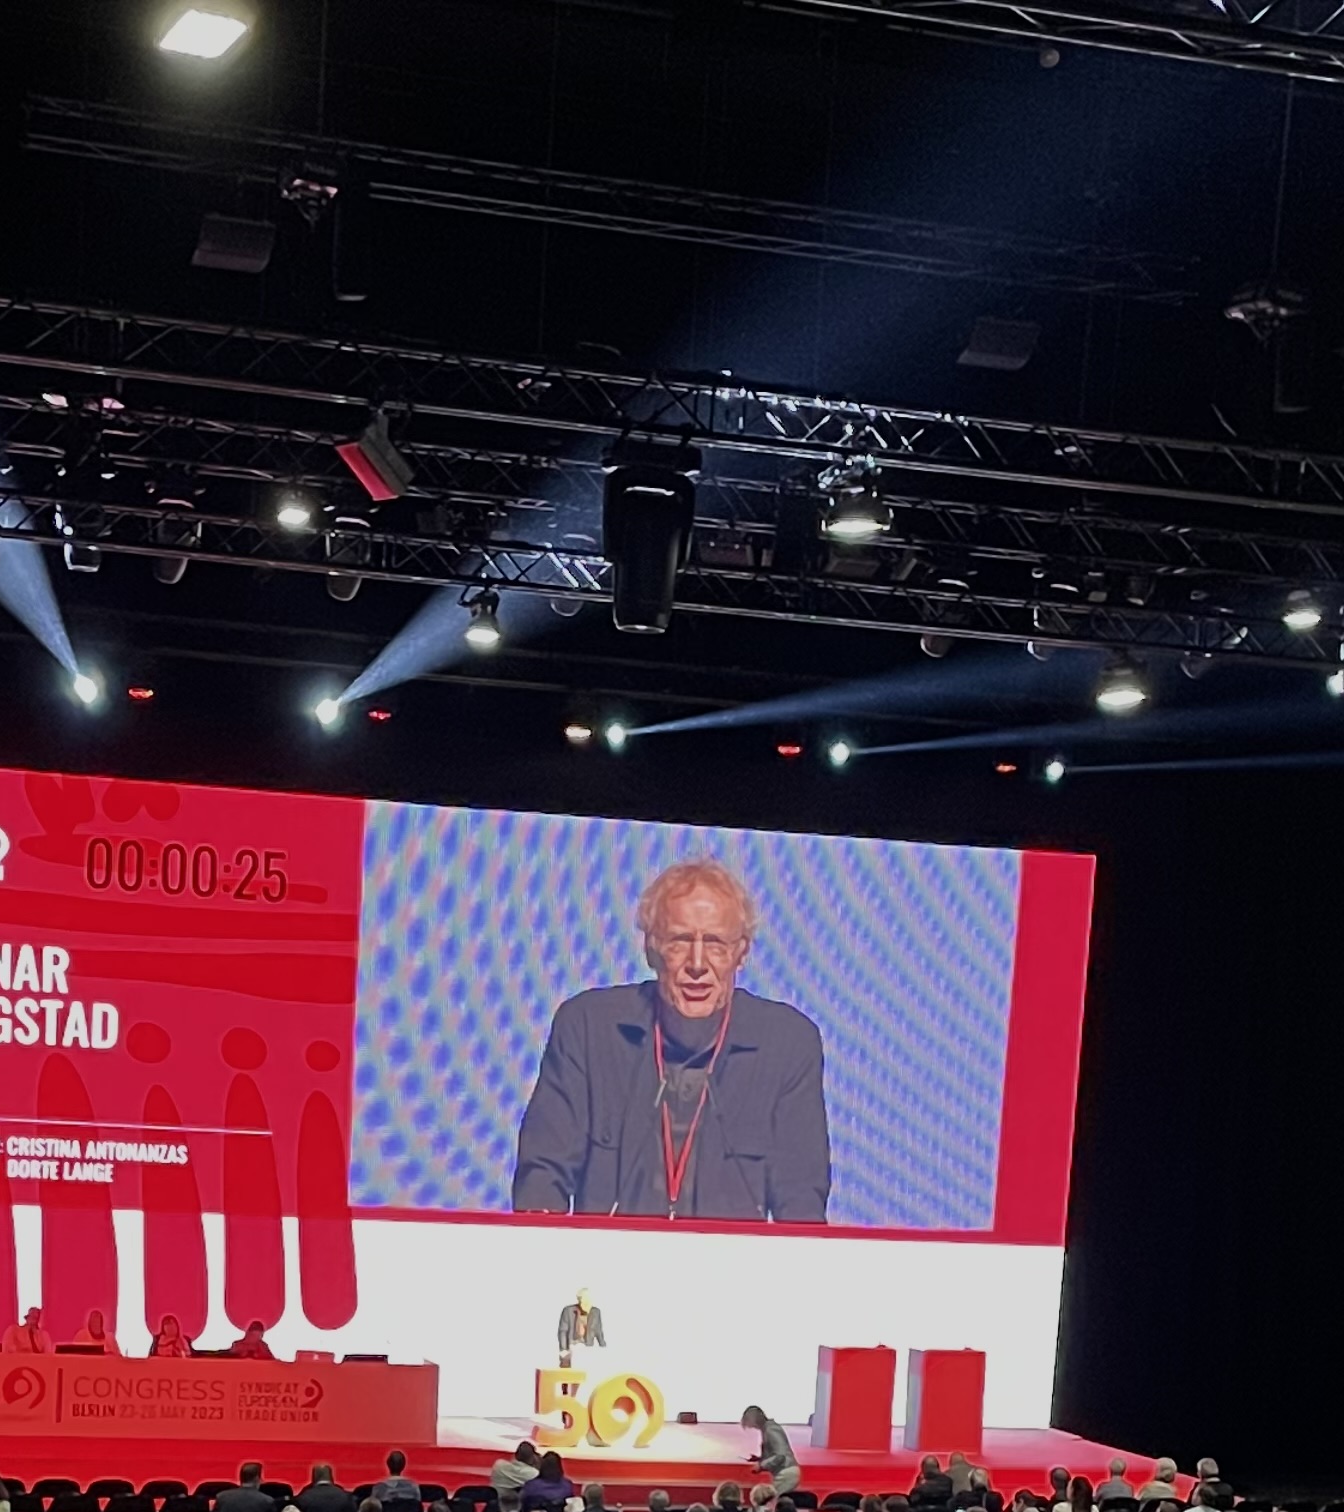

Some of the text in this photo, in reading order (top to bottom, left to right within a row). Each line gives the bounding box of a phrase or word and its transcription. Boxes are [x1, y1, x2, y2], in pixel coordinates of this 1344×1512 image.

[87, 838, 288, 903] 00:00:25
[6, 1136, 81, 1159] CRISTINA
[7, 1159, 113, 1182] DORTE LANGE
[73, 1376, 225, 1401] CONGRESS
[72, 1403, 115, 1417] BERLIN
[191, 1406, 224, 1420] 2023
[238, 1409, 319, 1422] TRADE UNION
